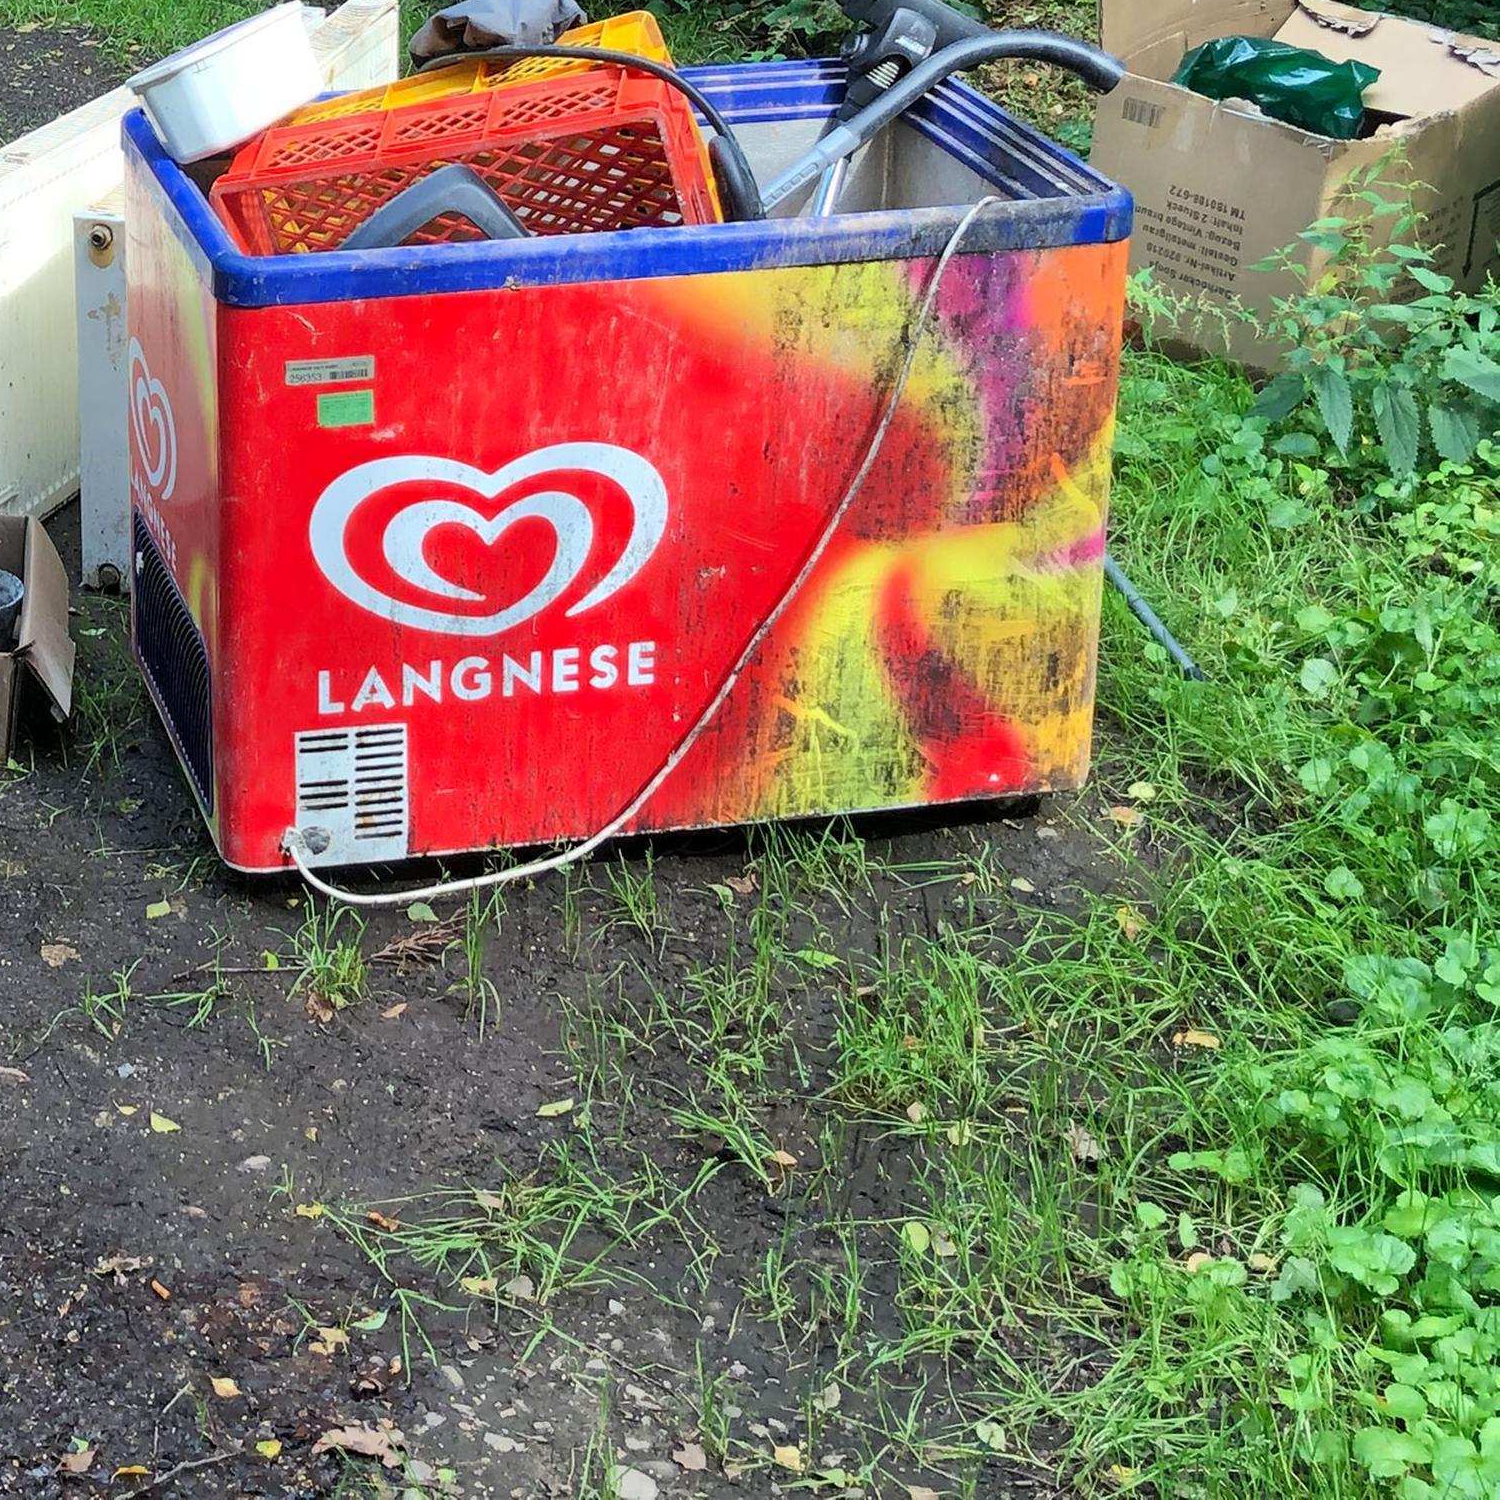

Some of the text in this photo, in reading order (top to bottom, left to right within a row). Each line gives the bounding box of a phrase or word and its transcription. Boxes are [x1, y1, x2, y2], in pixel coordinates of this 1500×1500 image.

[1135, 205, 1164, 222] braun
[1230, 206, 1246, 221] TM
[1165, 215, 1203, 237] Vintage
[317, 641, 656, 715] LANGNESE
